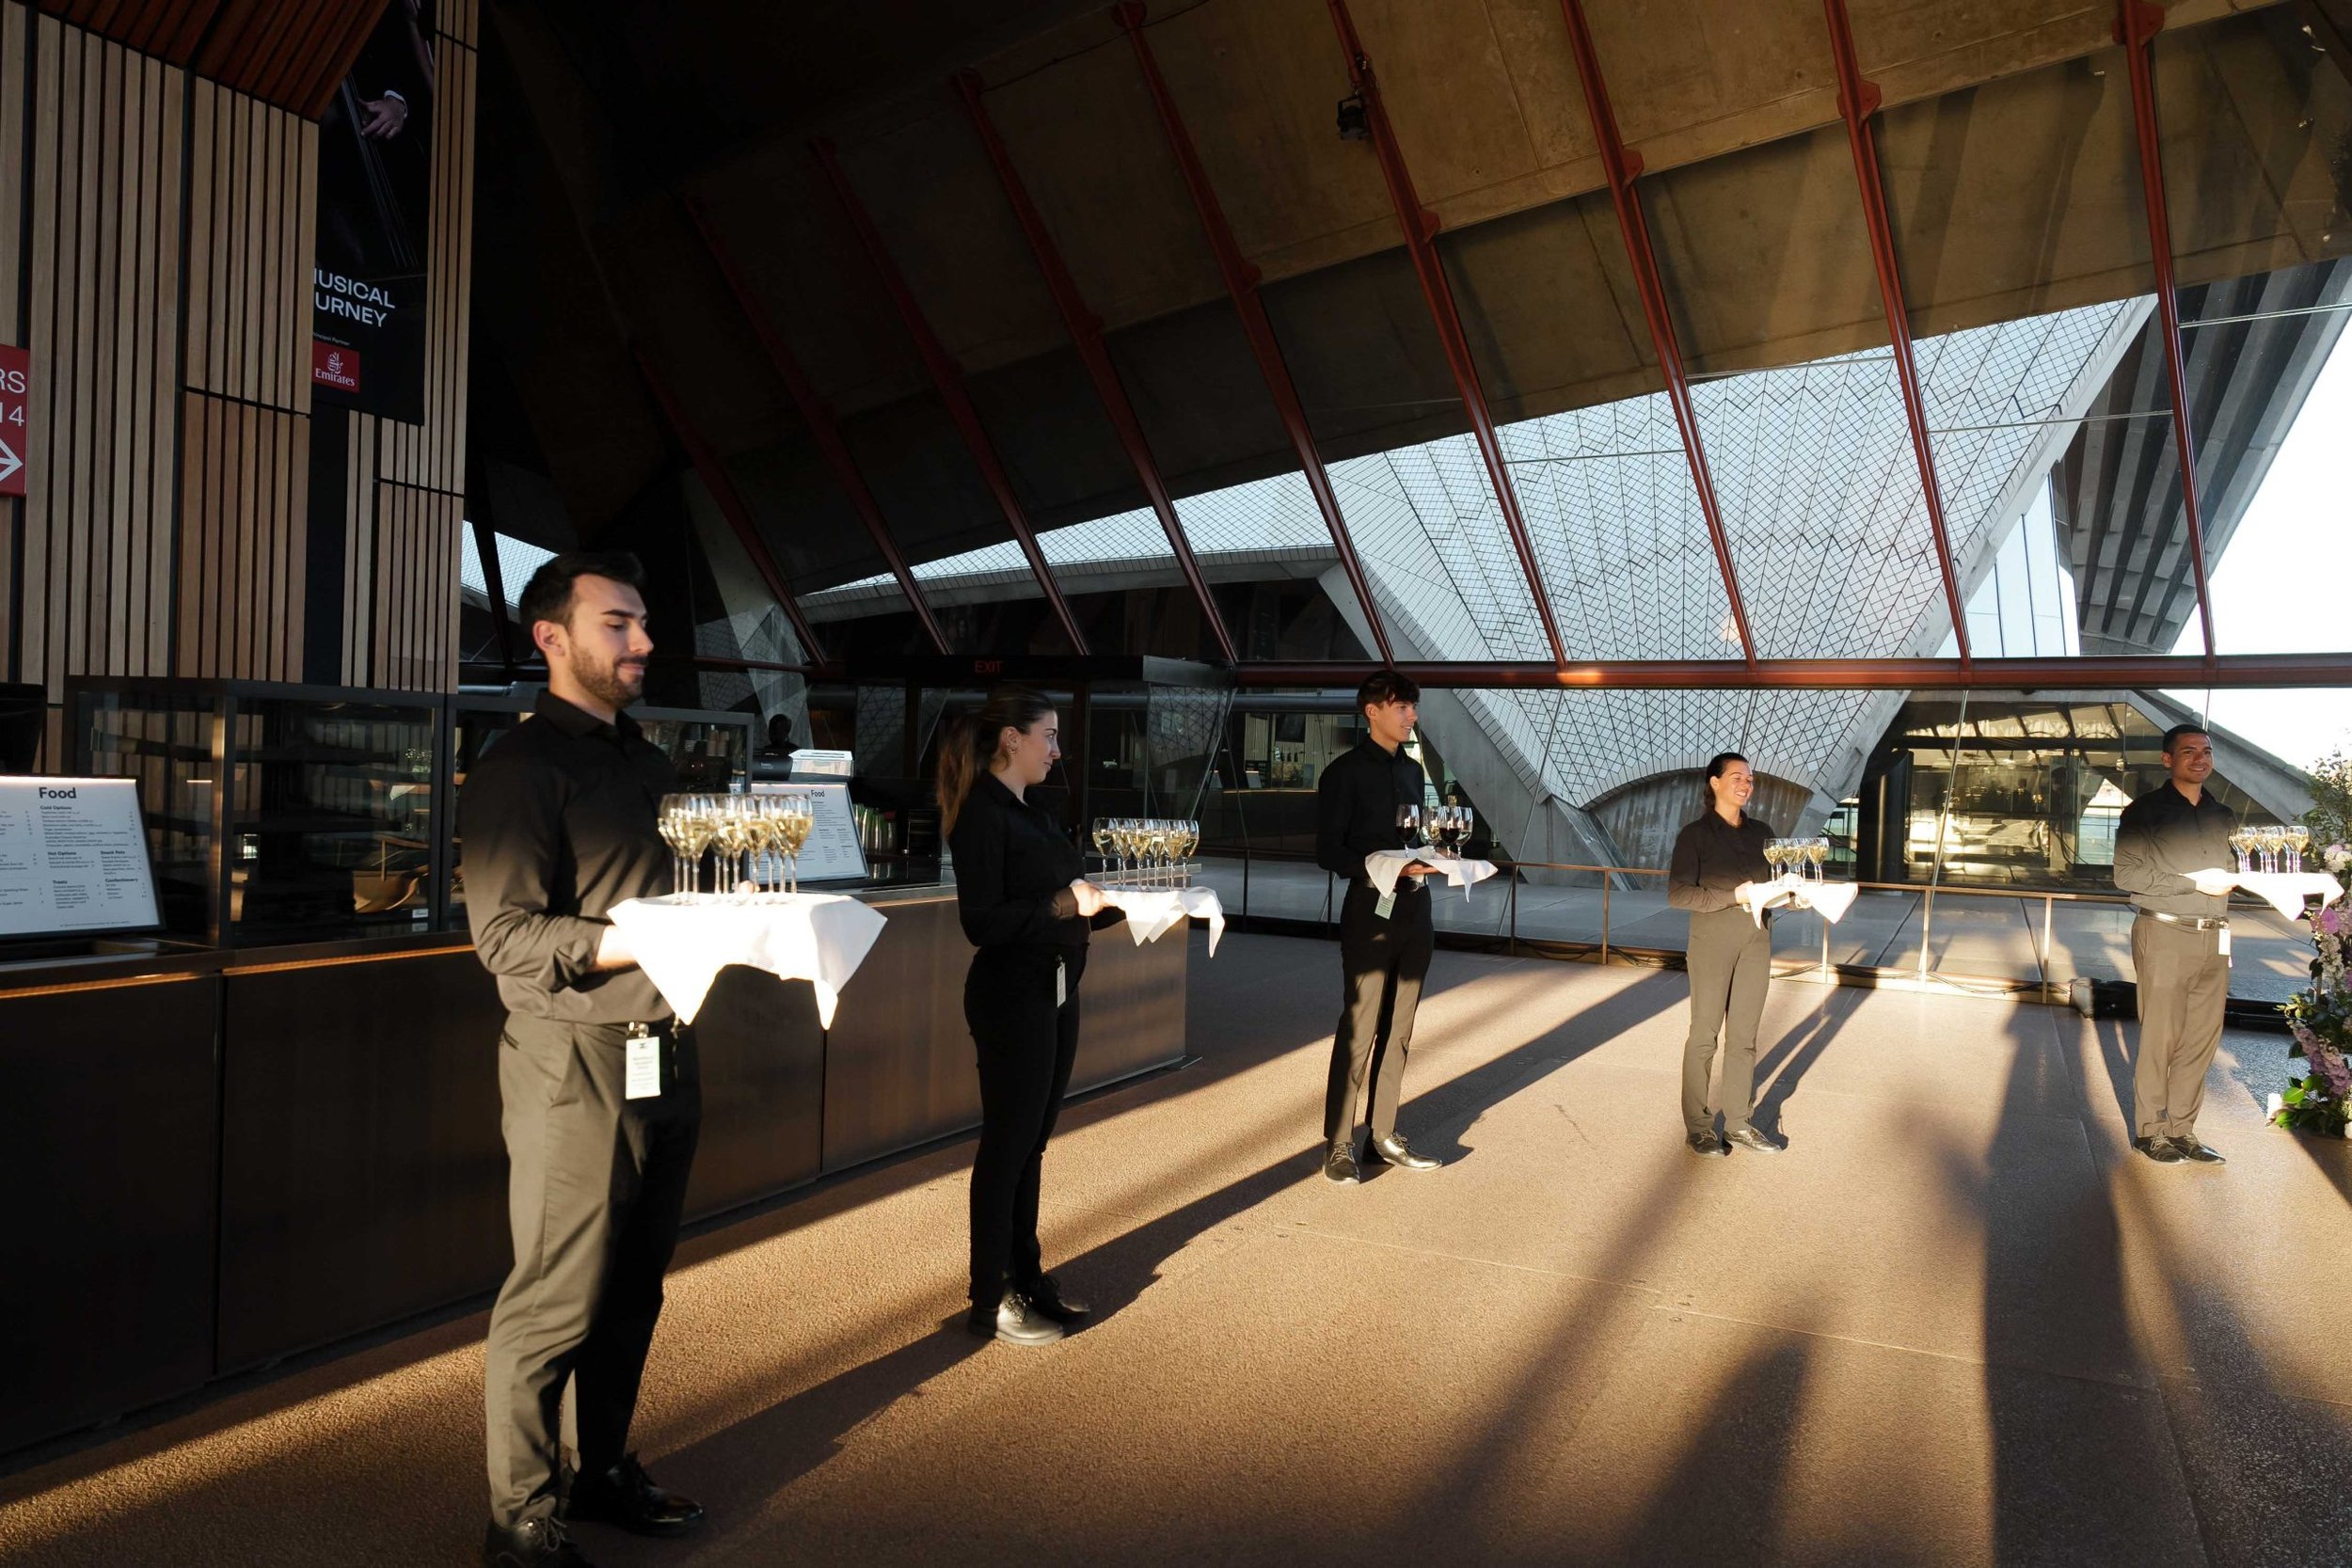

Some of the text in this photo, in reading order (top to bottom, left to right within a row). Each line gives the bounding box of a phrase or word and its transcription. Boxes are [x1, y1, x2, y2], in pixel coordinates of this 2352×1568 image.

[313, 268, 396, 309] USICAL
[315, 368, 355, 387] Emirates
[975, 660, 1004, 673] EXIT
[39, 786, 77, 800] Food
[811, 789, 825, 798] Food
